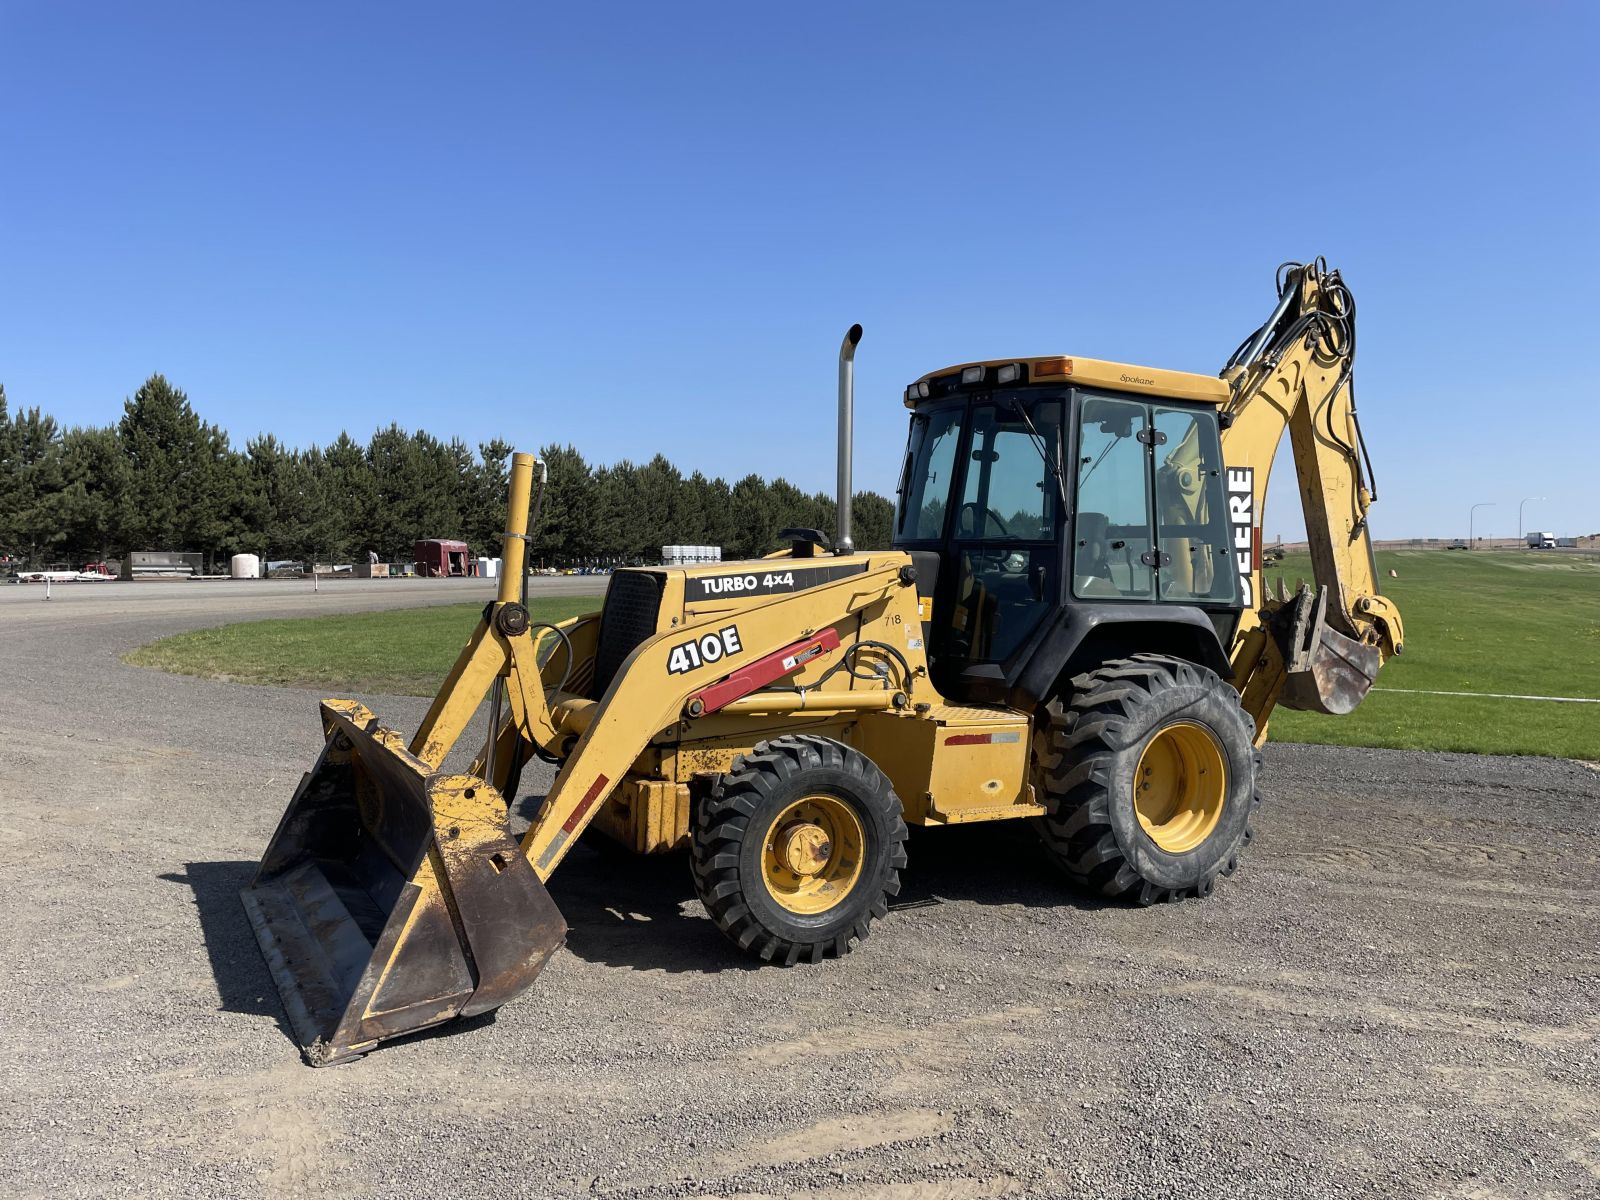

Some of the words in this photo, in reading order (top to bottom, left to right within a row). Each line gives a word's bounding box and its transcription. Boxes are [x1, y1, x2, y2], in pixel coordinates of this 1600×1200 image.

[1120, 373, 1155, 386] Spokane
[701, 575, 758, 594] TURBO
[763, 572, 795, 588] 4x4
[884, 614, 902, 627] 718
[668, 626, 742, 673] 410E
